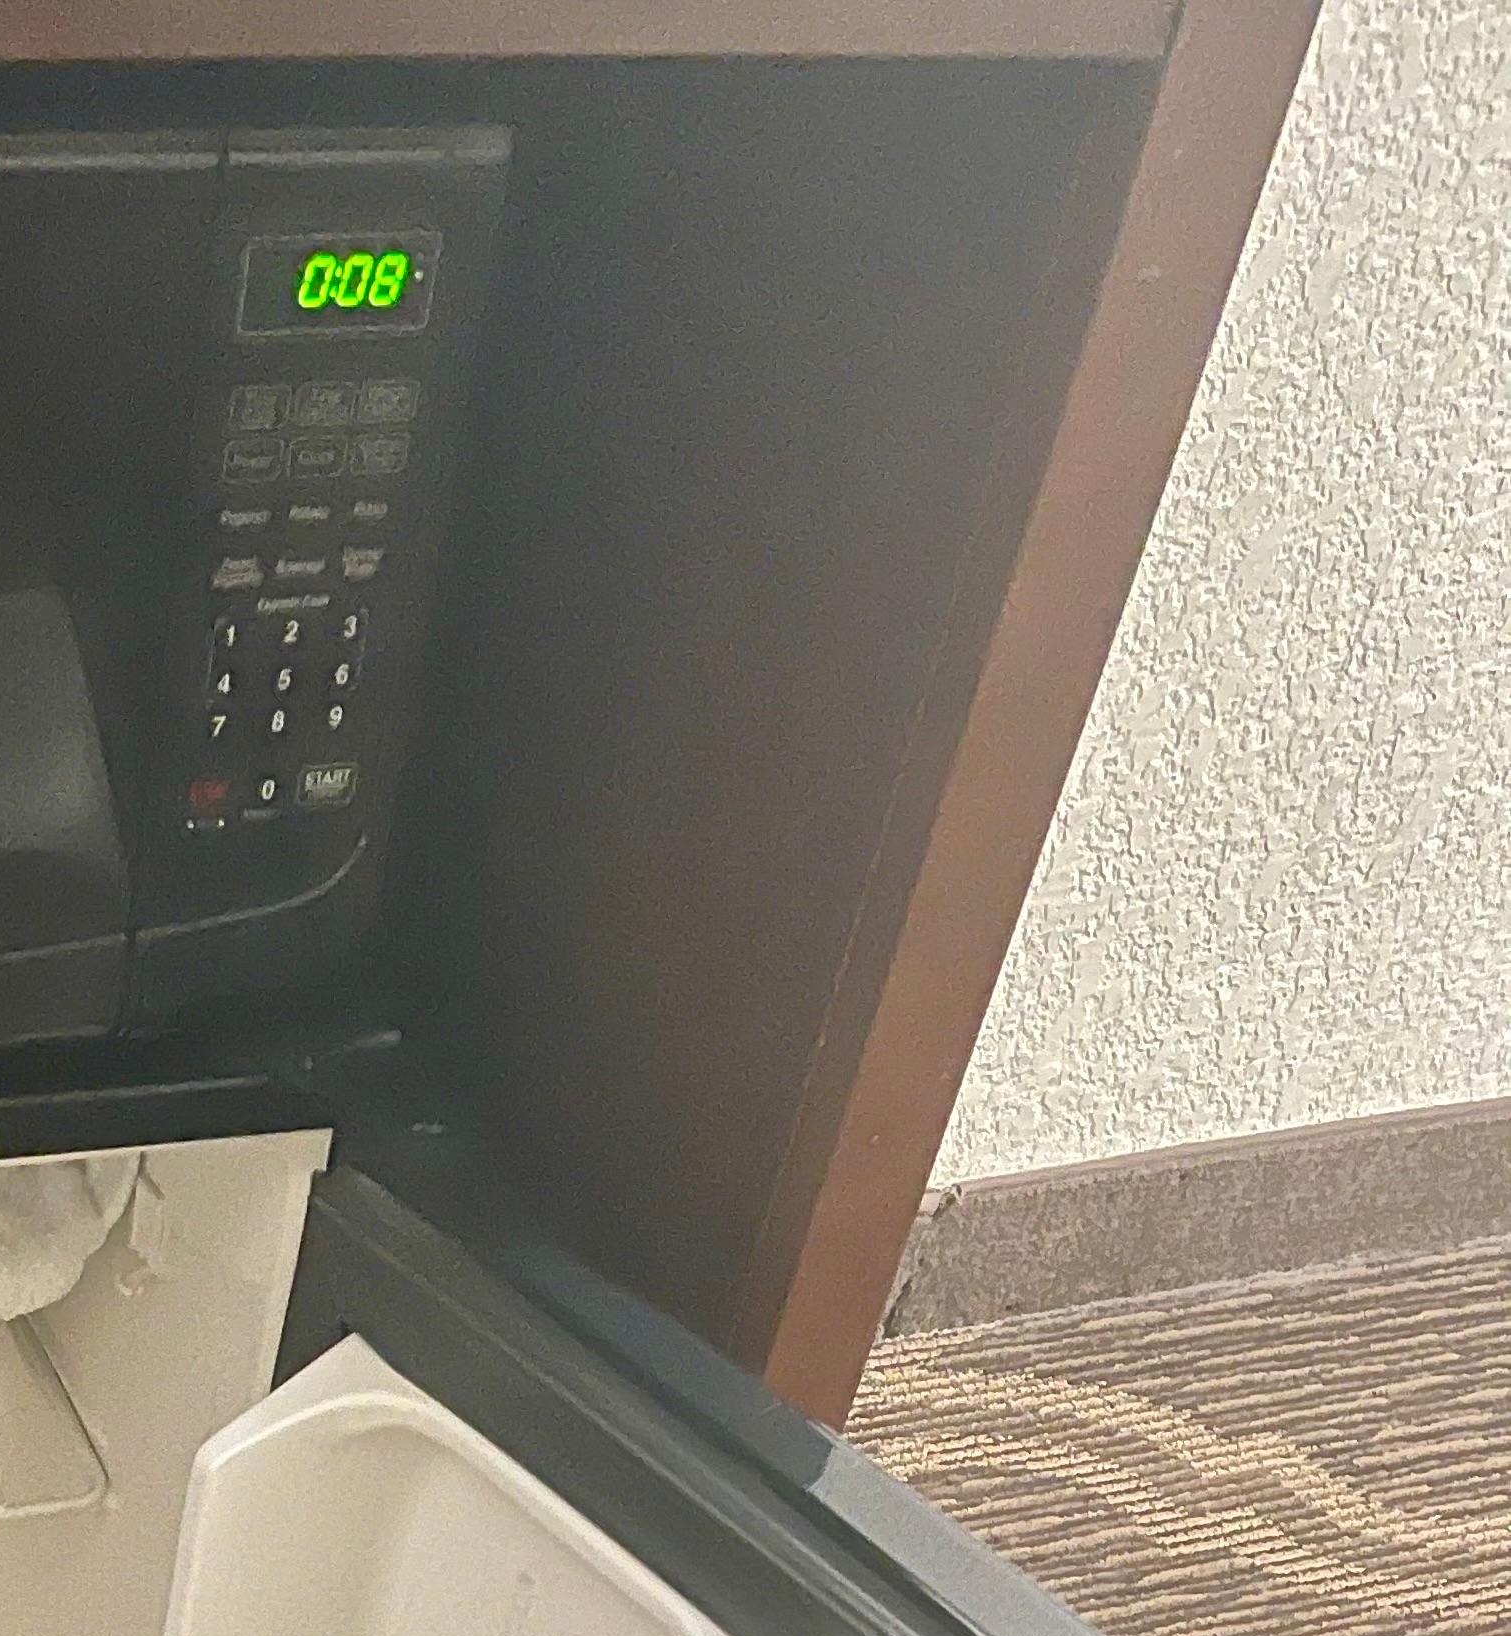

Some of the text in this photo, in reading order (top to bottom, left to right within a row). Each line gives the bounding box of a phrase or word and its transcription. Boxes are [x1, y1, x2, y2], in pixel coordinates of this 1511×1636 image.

[297, 253, 408, 308] 0:08
[226, 615, 358, 647] 1 2 3
[217, 663, 350, 694] 4 5 6
[211, 705, 343, 737] 7 8 9
[261, 779, 276, 801] 0
[305, 768, 351, 786] START
